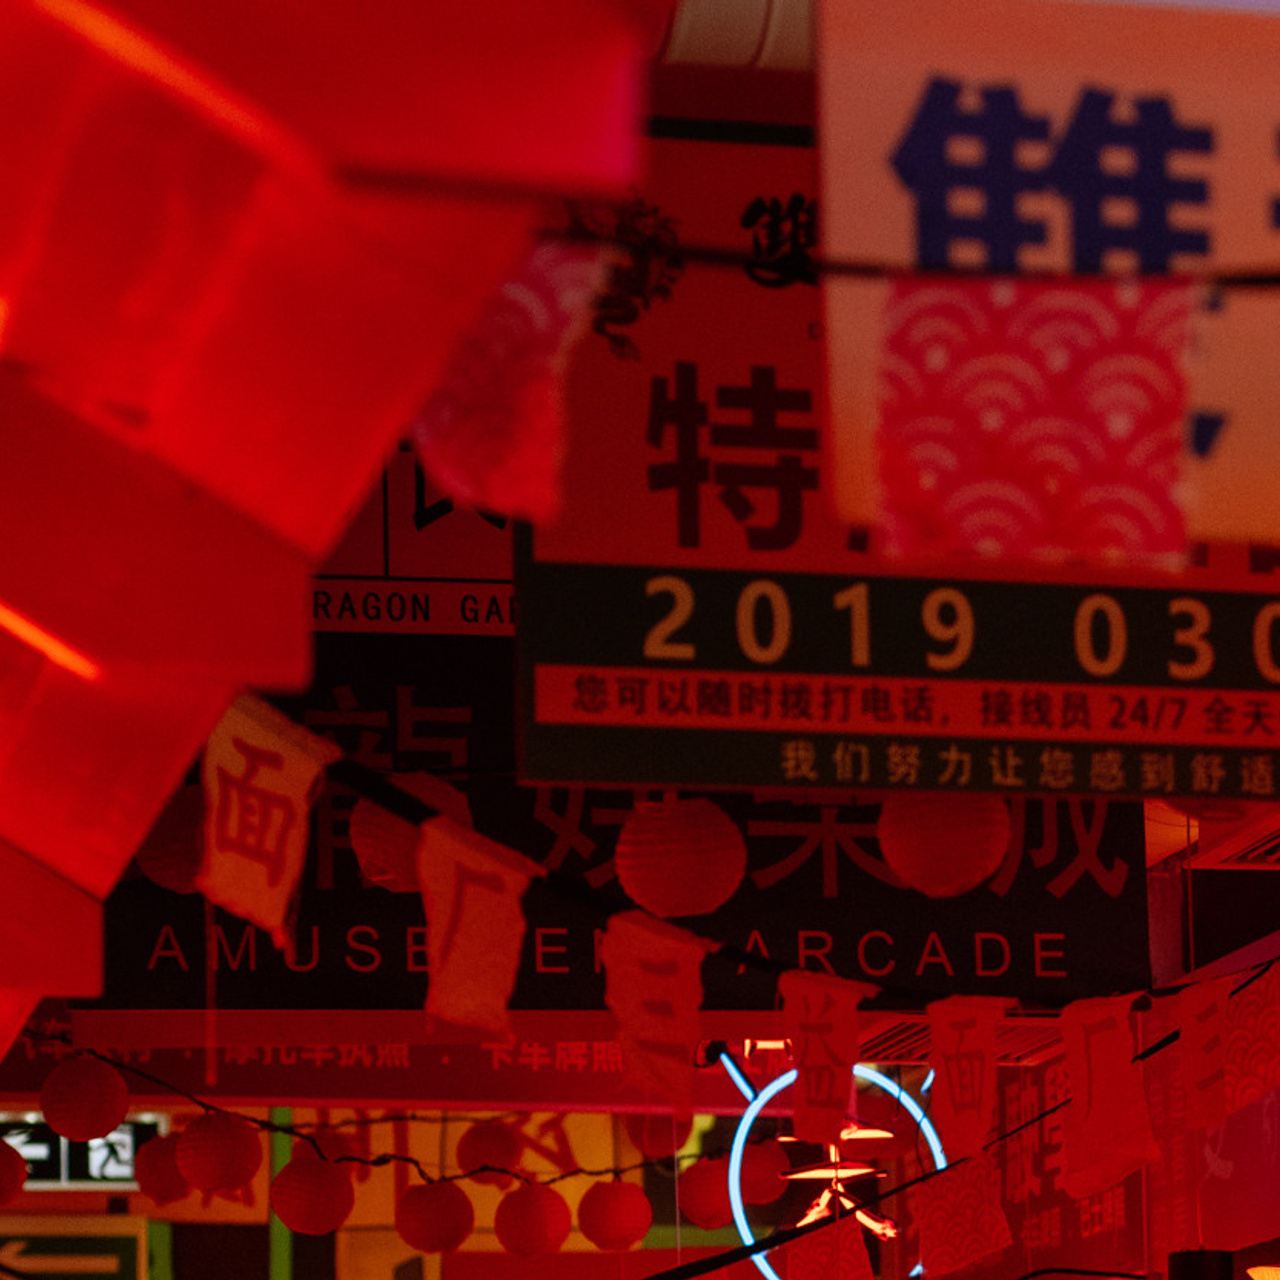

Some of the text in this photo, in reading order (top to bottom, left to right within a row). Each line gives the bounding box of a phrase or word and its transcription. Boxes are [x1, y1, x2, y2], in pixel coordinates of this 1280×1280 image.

[313, 590, 515, 623] RAGON GA
[642, 576, 976, 672] 2019
[1108, 695, 1188, 732] 24/7
[781, 740, 1275, 796] 我们努力让您感到舒适
[146, 924, 1069, 979] AMUSEE ARCADE
